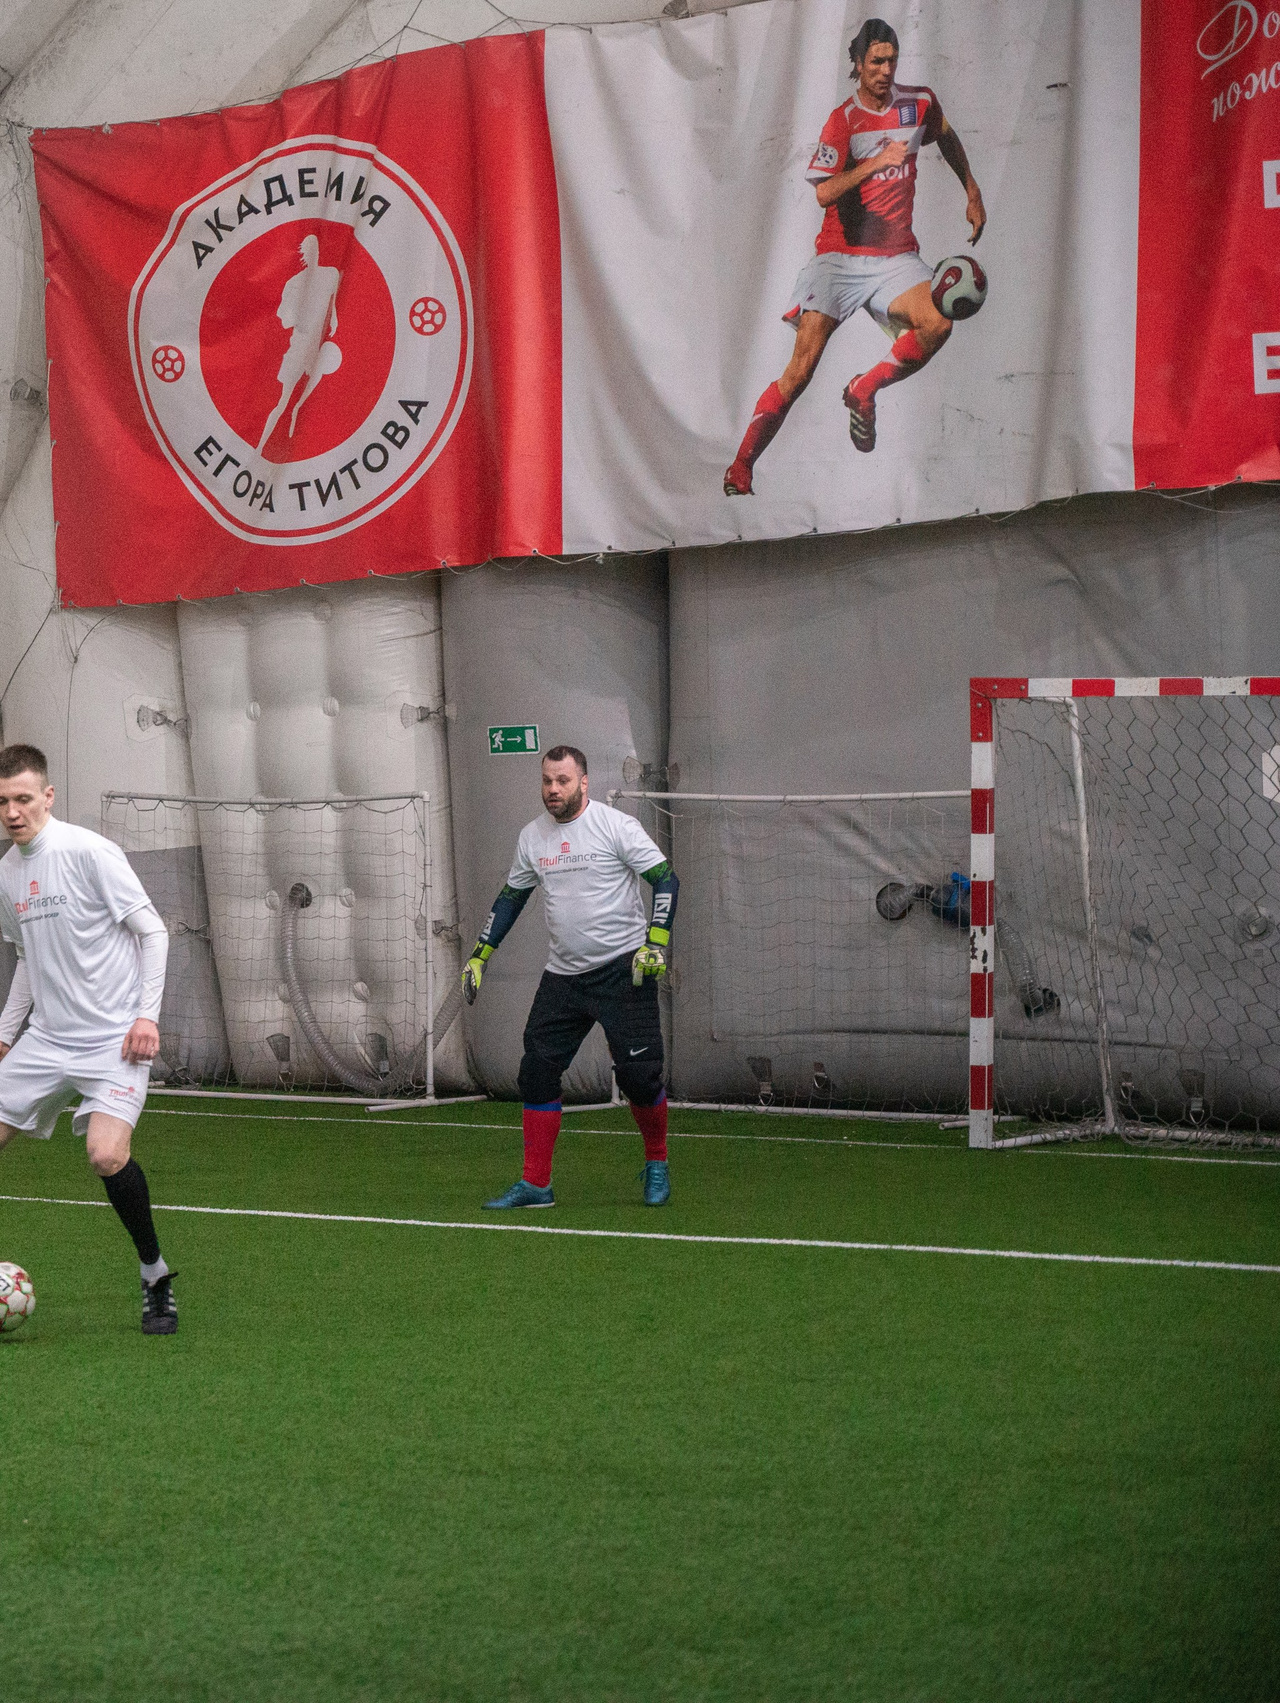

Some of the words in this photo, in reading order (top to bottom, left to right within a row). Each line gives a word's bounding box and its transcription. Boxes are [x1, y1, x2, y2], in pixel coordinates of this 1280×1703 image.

[193, 435, 275, 513] ЕГОРА
[288, 398, 429, 511] ТИТОВА
[538, 853, 597, 868] TitulFinance
